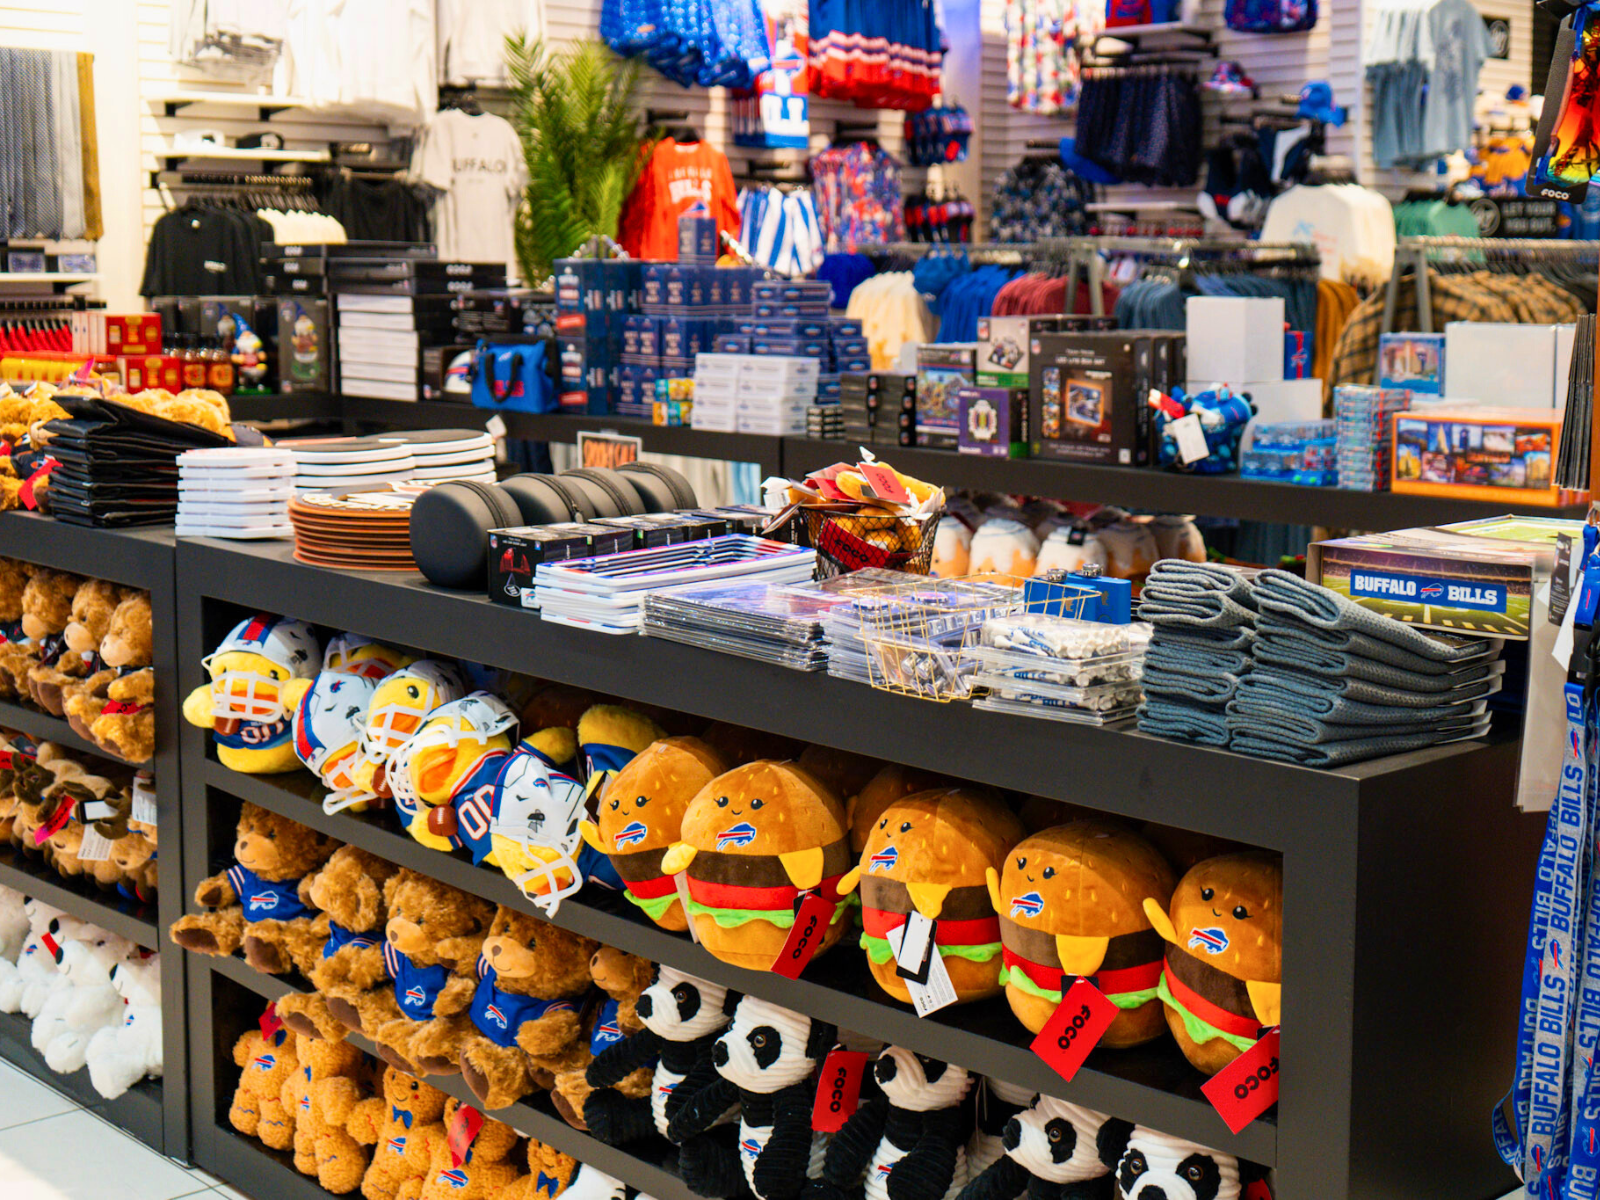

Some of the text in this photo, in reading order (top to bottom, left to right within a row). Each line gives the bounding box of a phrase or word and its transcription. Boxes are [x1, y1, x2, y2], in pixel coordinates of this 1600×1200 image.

[1541, 188, 1569, 200] FOCO
[835, 539, 869, 562] FOCO
[1354, 575, 1498, 606] BUFFALO BILLS
[1560, 764, 1583, 828] BILLS
[1550, 834, 1577, 933] BUFFALO
[793, 915, 817, 959] FOCO
[1058, 1003, 1091, 1050] FOCO
[1531, 974, 1566, 1135] BUFFALO BILLS
[830, 1066, 846, 1113] FOCO
[1234, 1056, 1279, 1099] FOCO
